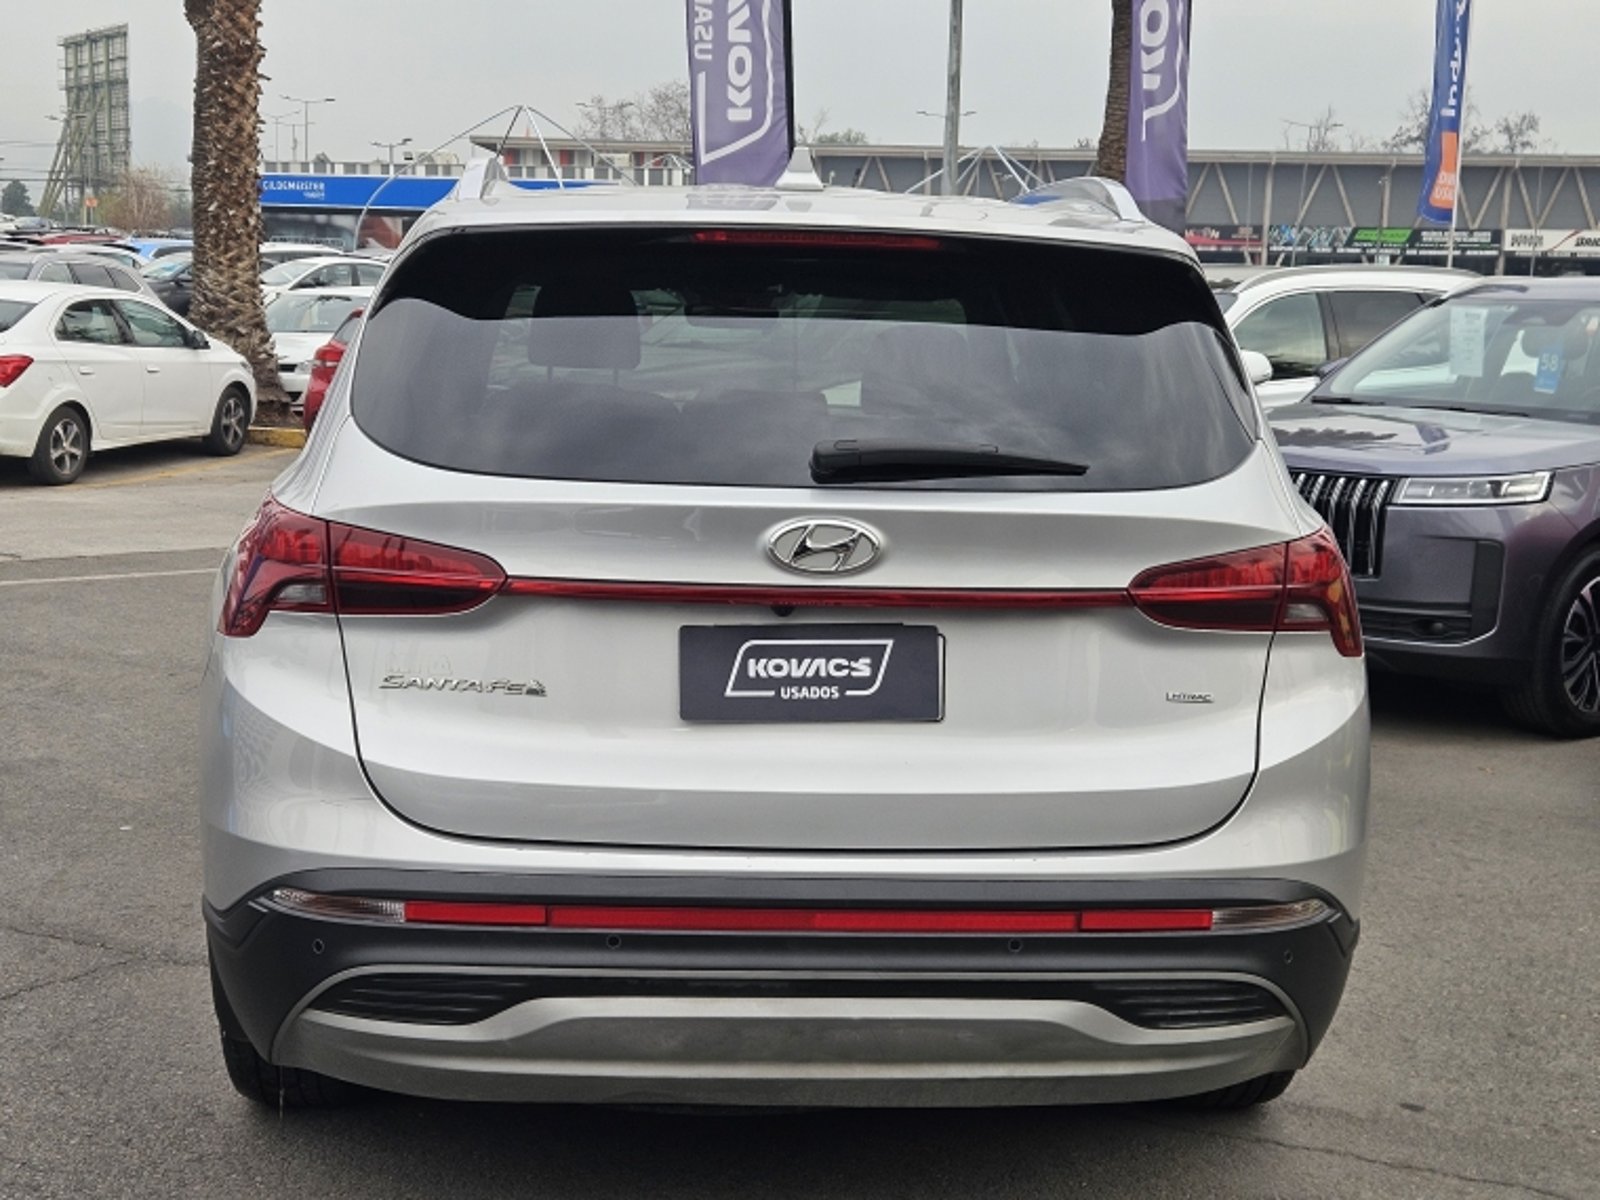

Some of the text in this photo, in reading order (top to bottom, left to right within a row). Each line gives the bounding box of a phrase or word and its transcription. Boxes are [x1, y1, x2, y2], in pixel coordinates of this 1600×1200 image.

[1540, 353, 1559, 372] 58
[747, 657, 872, 679] KOVACS
[780, 685, 840, 700] USADOS
